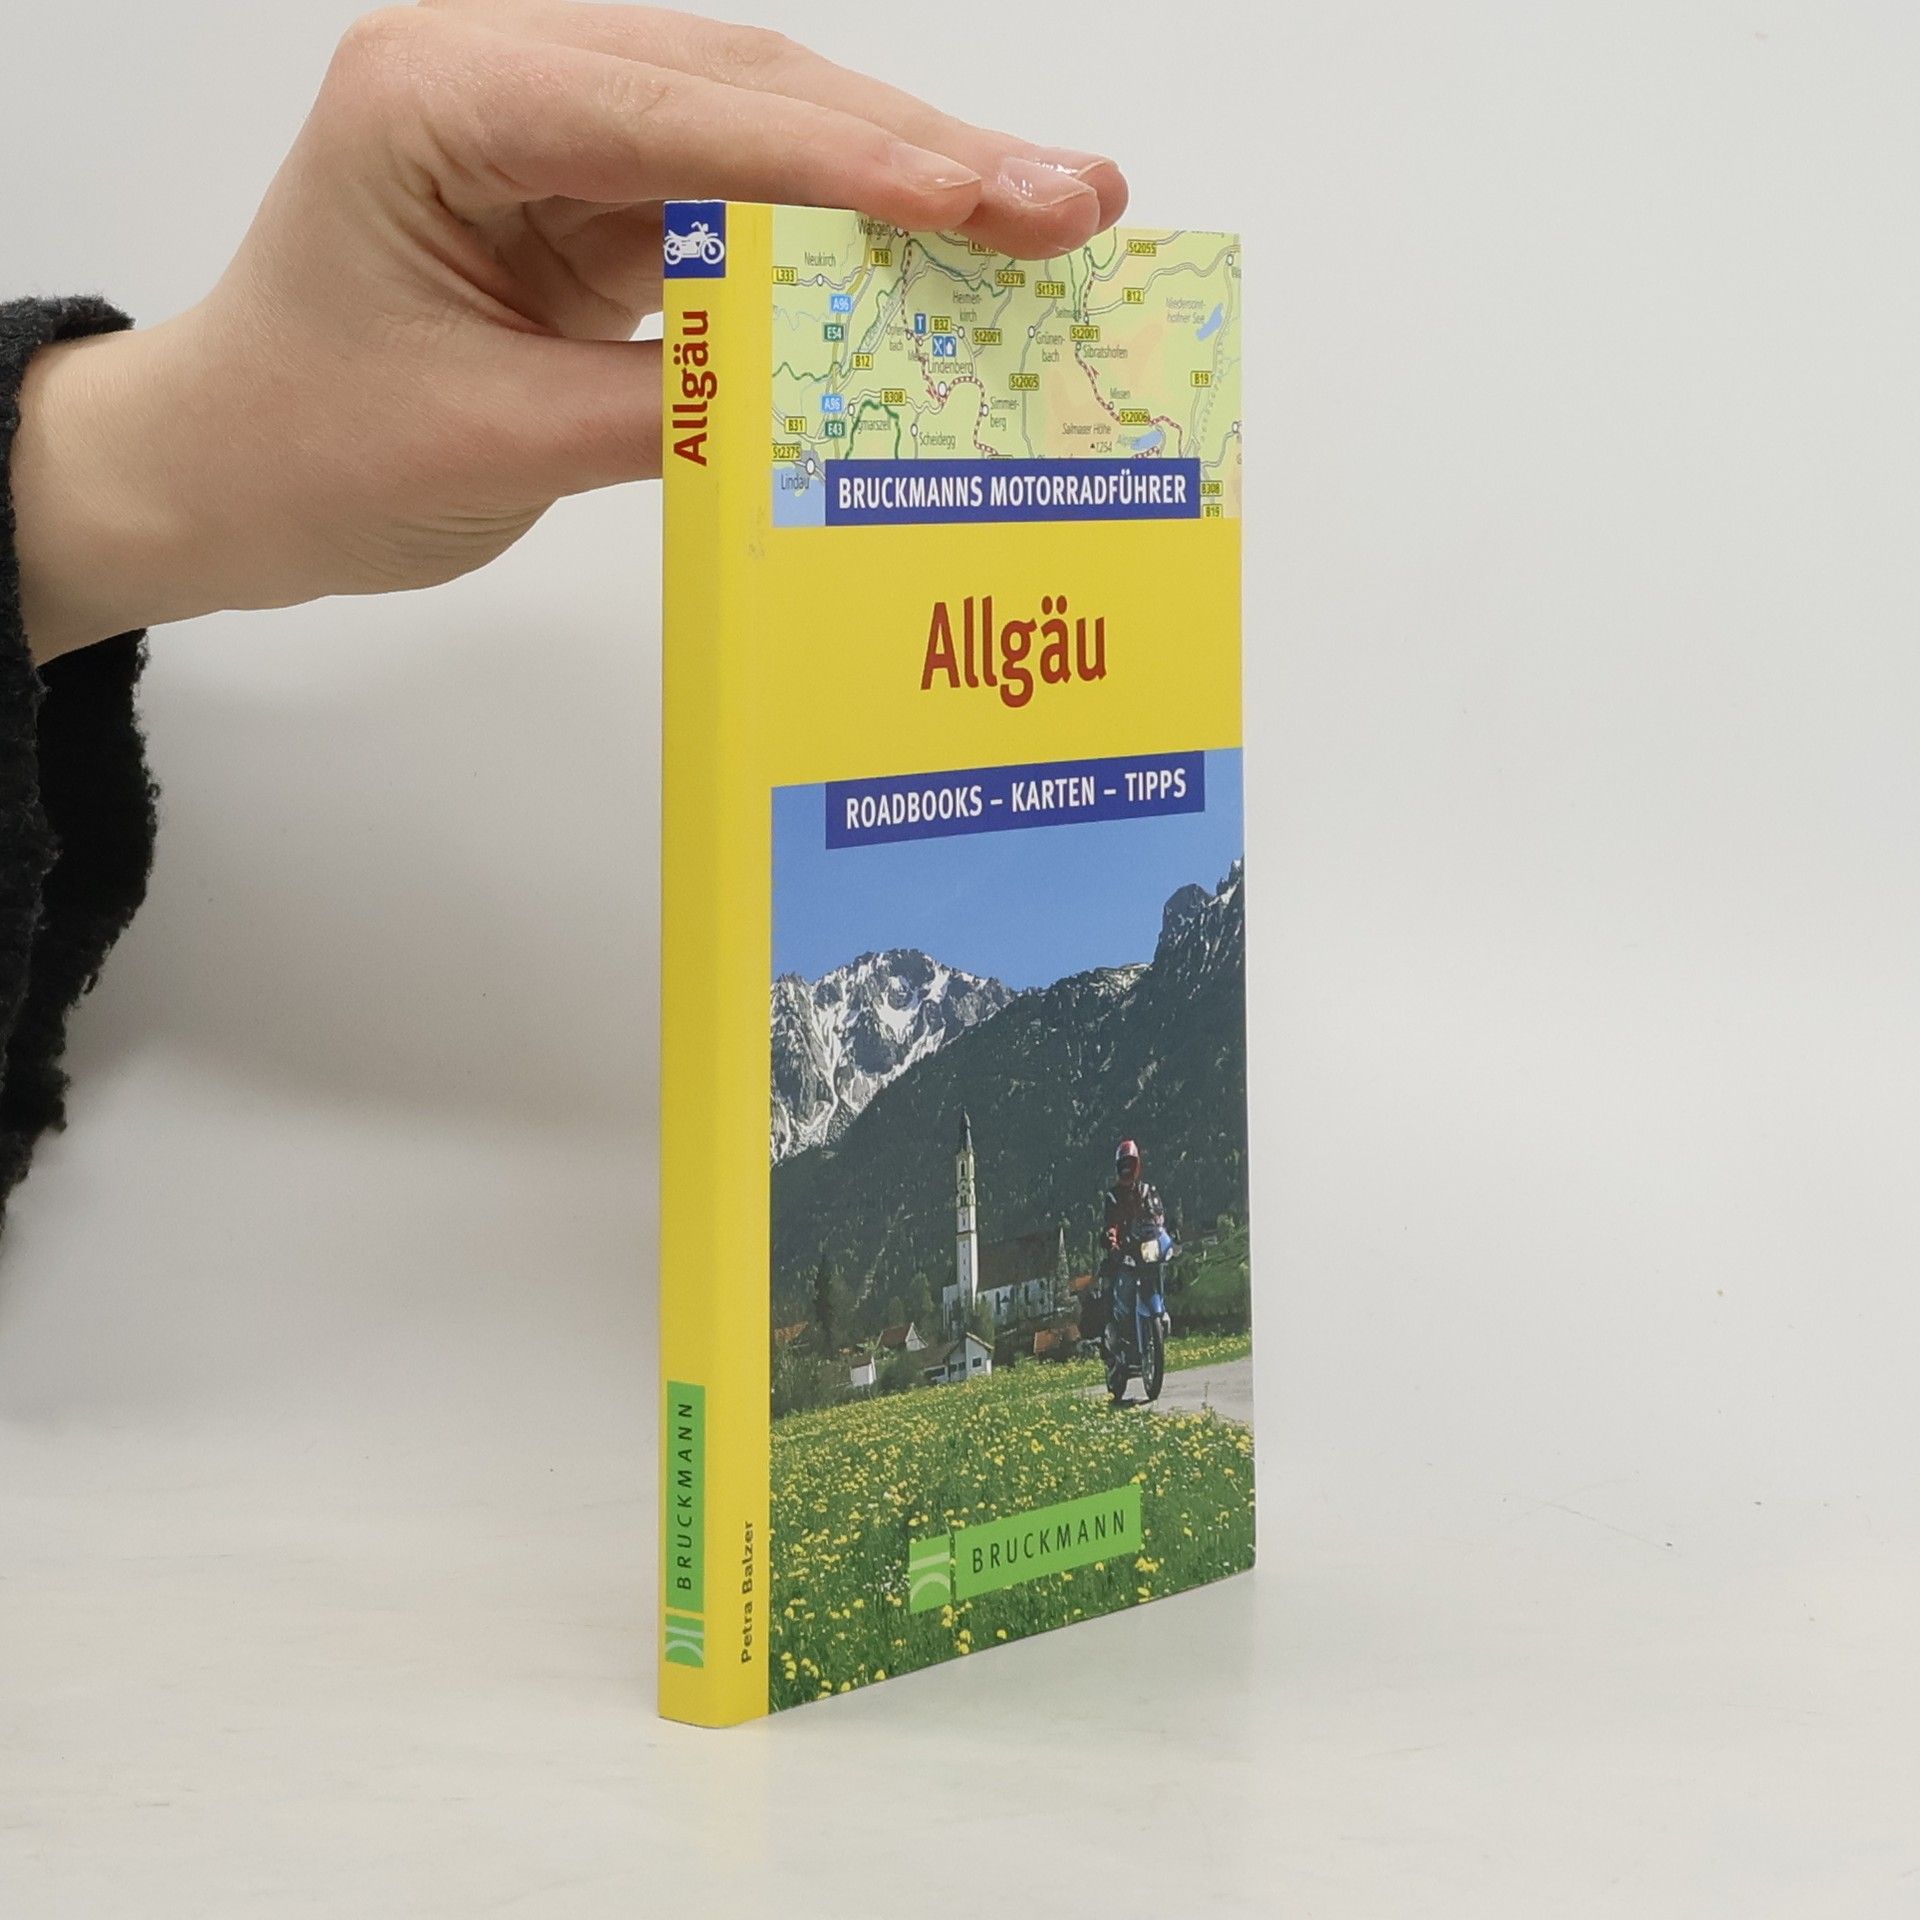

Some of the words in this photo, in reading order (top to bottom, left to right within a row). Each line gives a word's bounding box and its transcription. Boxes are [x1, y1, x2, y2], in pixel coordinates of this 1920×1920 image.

[874, 251, 889, 264] B18
[776, 269, 795, 282] L333
[1127, 290, 1141, 302] B12
[934, 318, 949, 330] B32
[826, 326, 842, 340] E54
[974, 331, 1001, 343] St2001
[1072, 328, 1099, 340] St2001
[855, 356, 870, 367] B12
[1011, 376, 1038, 388] St2005
[1194, 372, 1209, 384] B19
[672, 310, 718, 467] Allgäu
[883, 391, 903, 403] B308
[1121, 411, 1149, 422] St2006
[788, 419, 803, 431] B31
[828, 423, 843, 437] E43
[773, 444, 801, 459] St2375
[781, 473, 809, 489] Lindau
[838, 476, 982, 509] BRUCKMANNS
[989, 469, 1187, 507] MOTORRADFÜHRER
[920, 594, 1107, 709] Allgäu
[846, 785, 983, 830] ROADBOOKS
[1011, 776, 1095, 813] KARTEN
[1125, 767, 1187, 802] TIPPS
[676, 1403, 693, 1590] BRUCKMANN
[971, 1509, 1124, 1574] BRUCKMANN
[741, 1520, 754, 1596] Balzer
[741, 1600, 754, 1664] Petra
